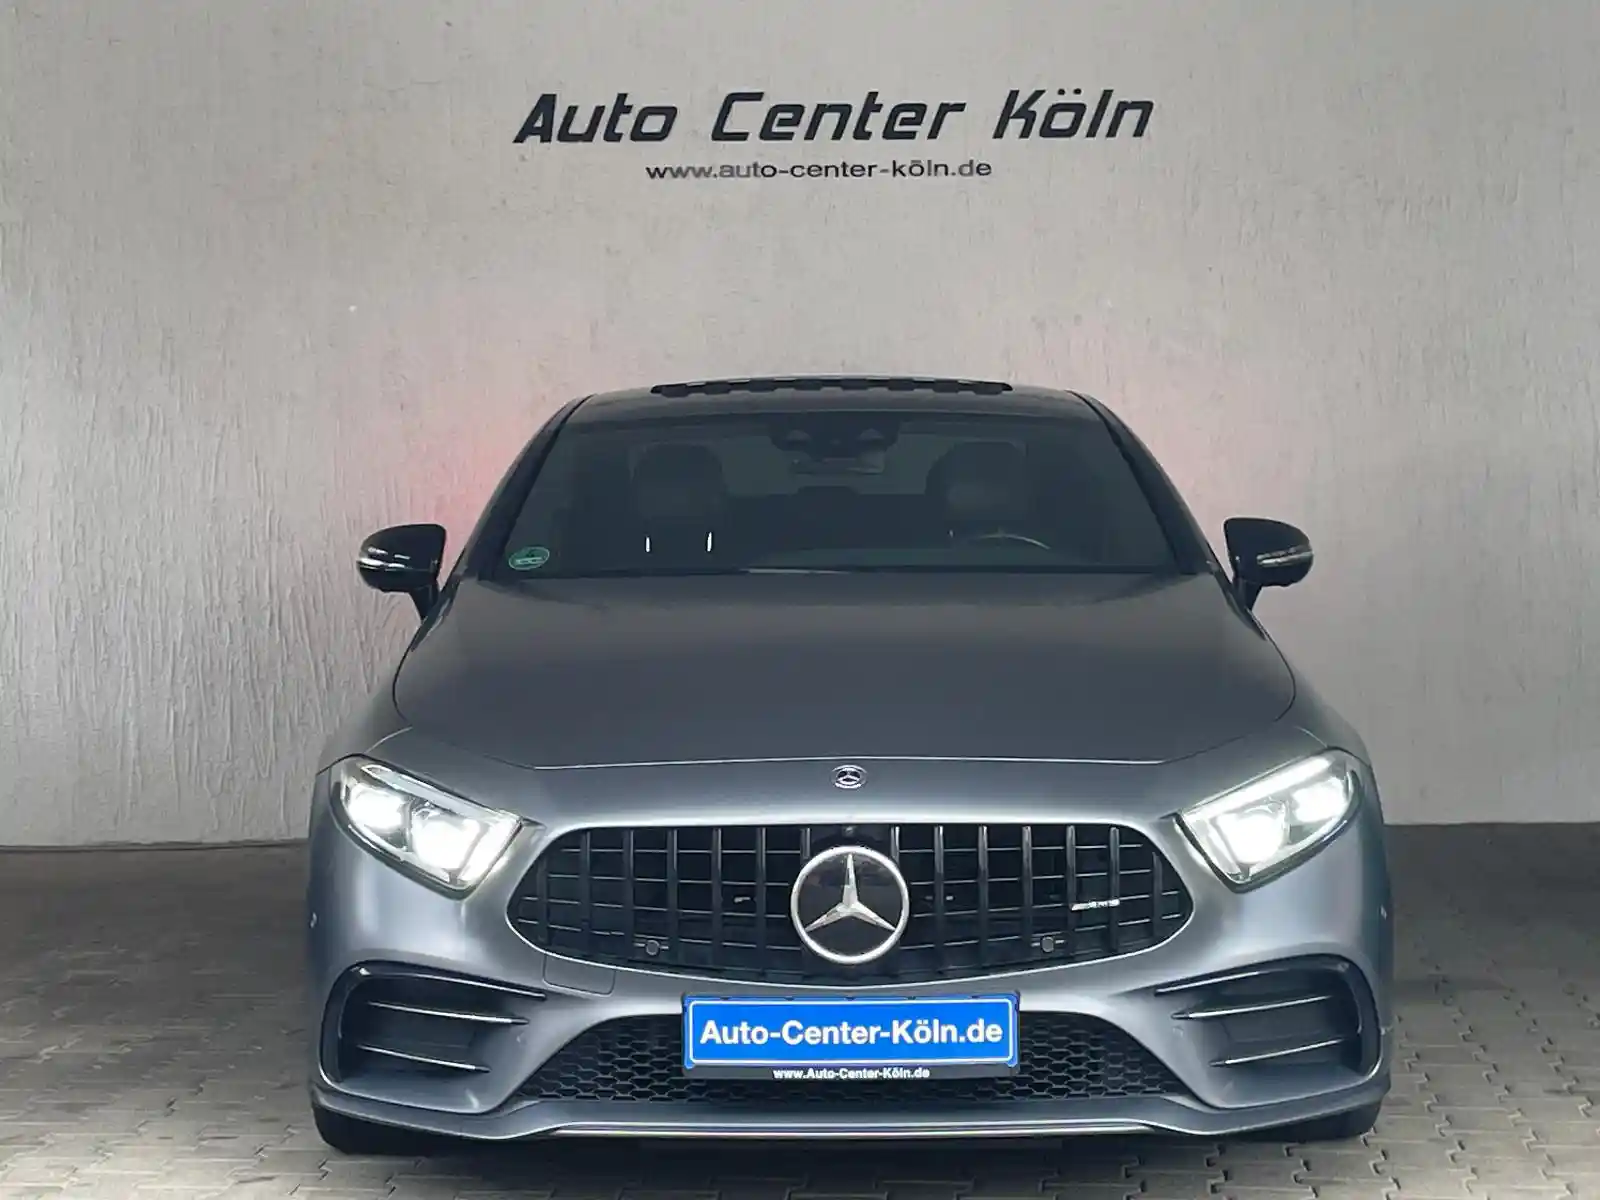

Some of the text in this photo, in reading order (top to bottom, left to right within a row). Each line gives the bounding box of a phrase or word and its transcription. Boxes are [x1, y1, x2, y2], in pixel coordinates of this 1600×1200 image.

[513, 88, 1154, 144] Auto Center Köln
[646, 160, 992, 180] www.auto-center-köln.de
[700, 1018, 1003, 1045] Auto-Center-Köln.de
[773, 1067, 930, 1080] www.Auto-Center-Köln.de
